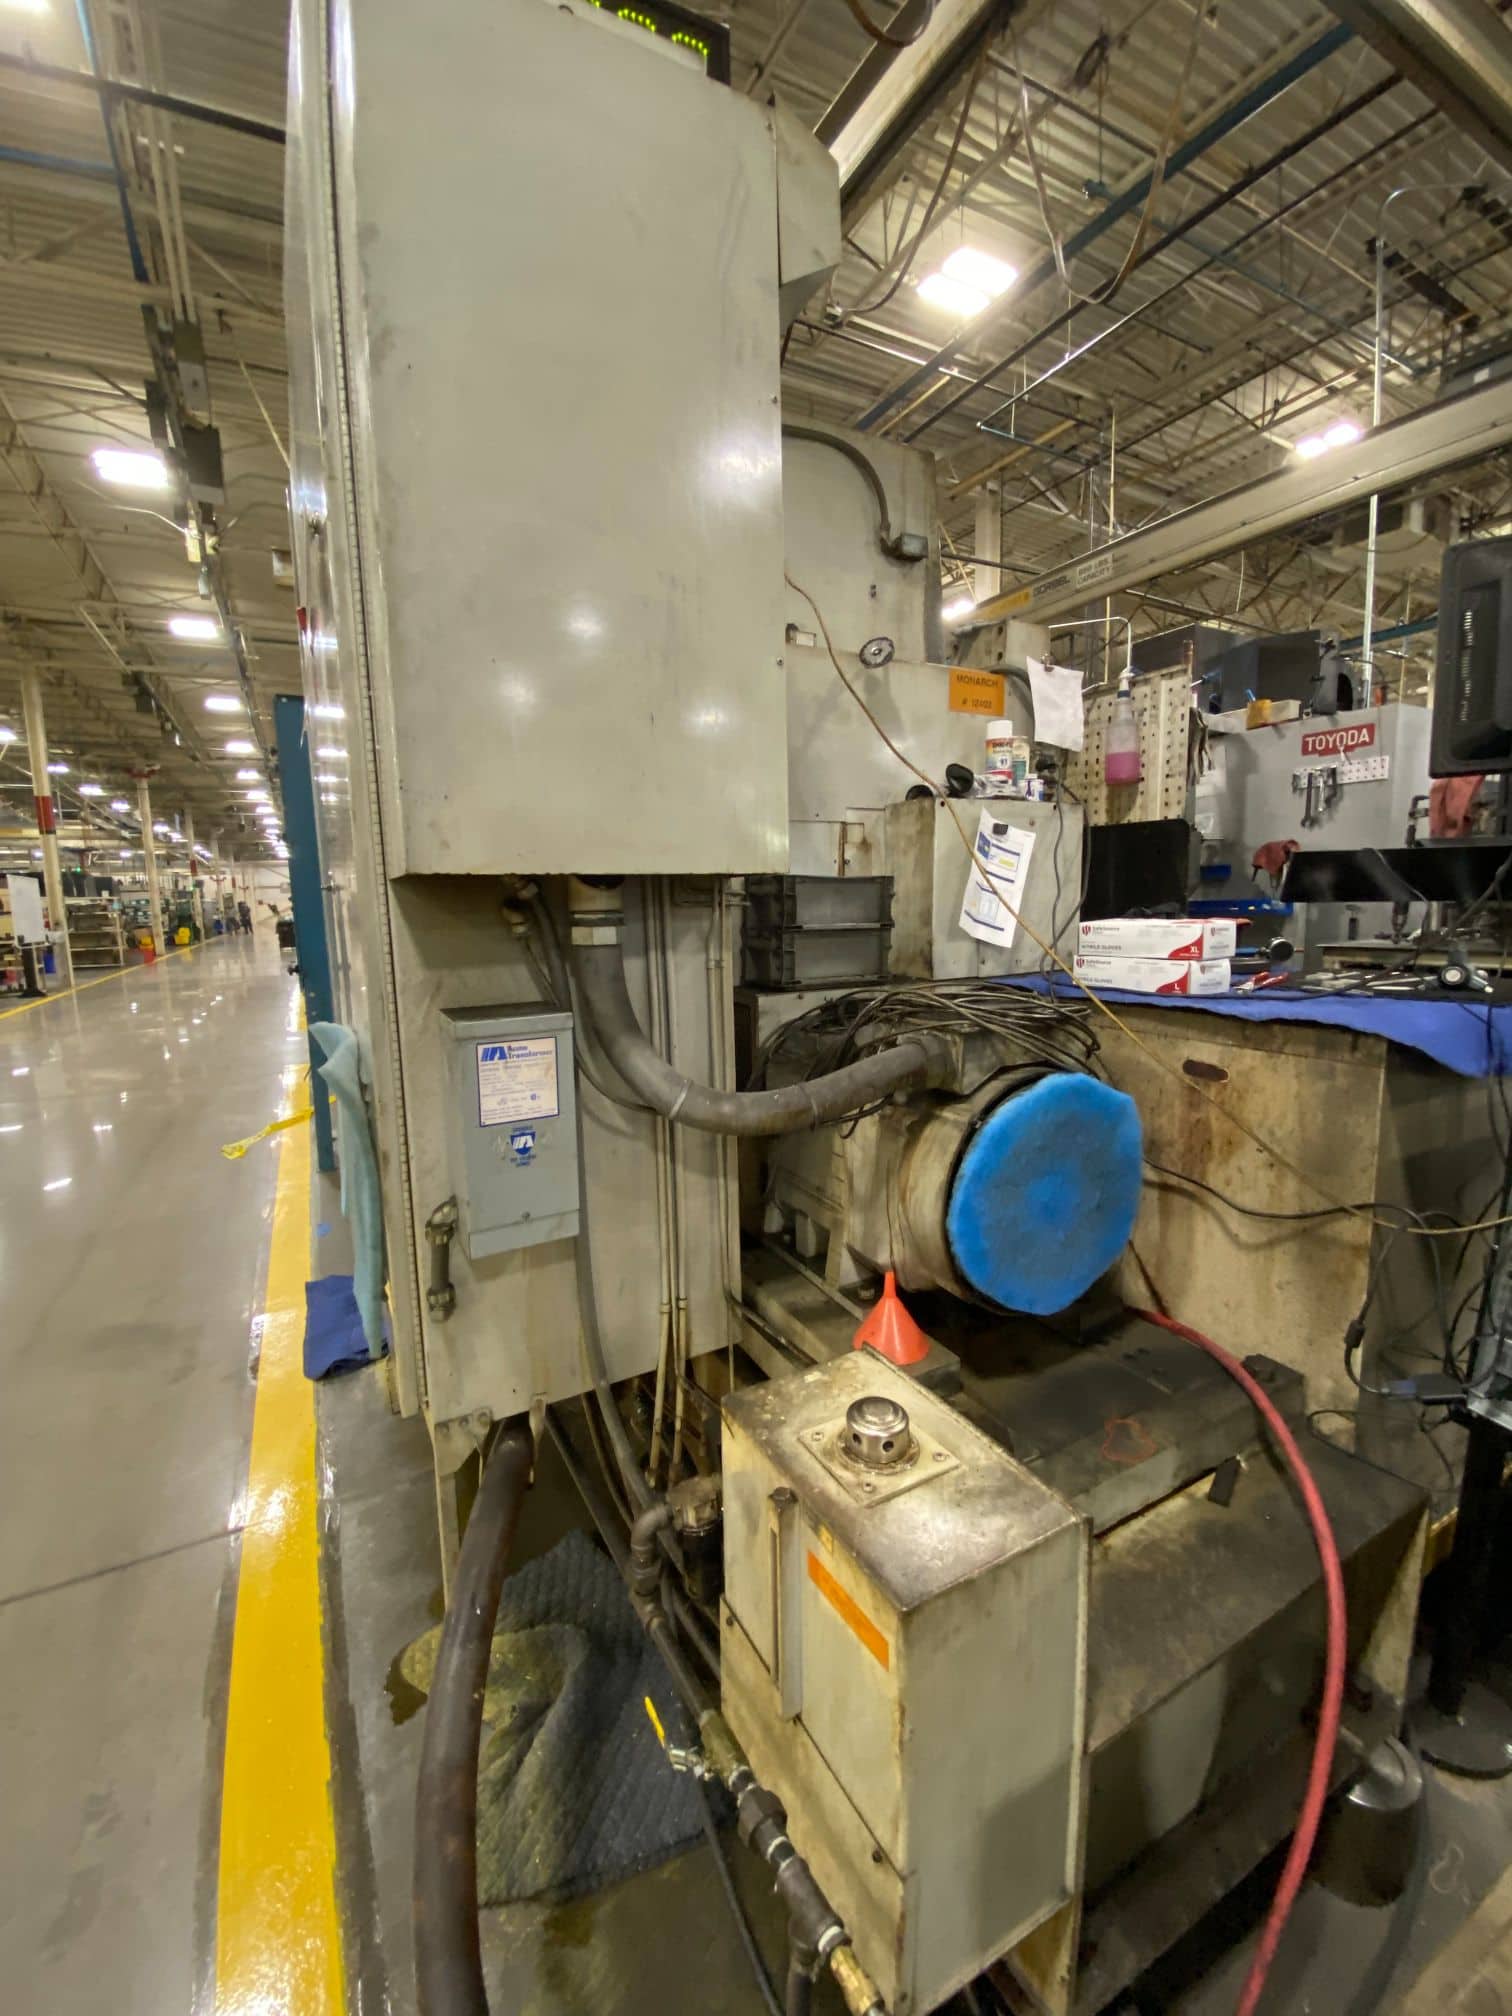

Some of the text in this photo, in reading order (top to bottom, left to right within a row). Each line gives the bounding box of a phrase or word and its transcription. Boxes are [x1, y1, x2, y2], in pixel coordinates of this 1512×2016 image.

[956, 673, 999, 688] MONARCH
[1304, 727, 1370, 752] TOYODA
[1190, 946, 1200, 954] XL
